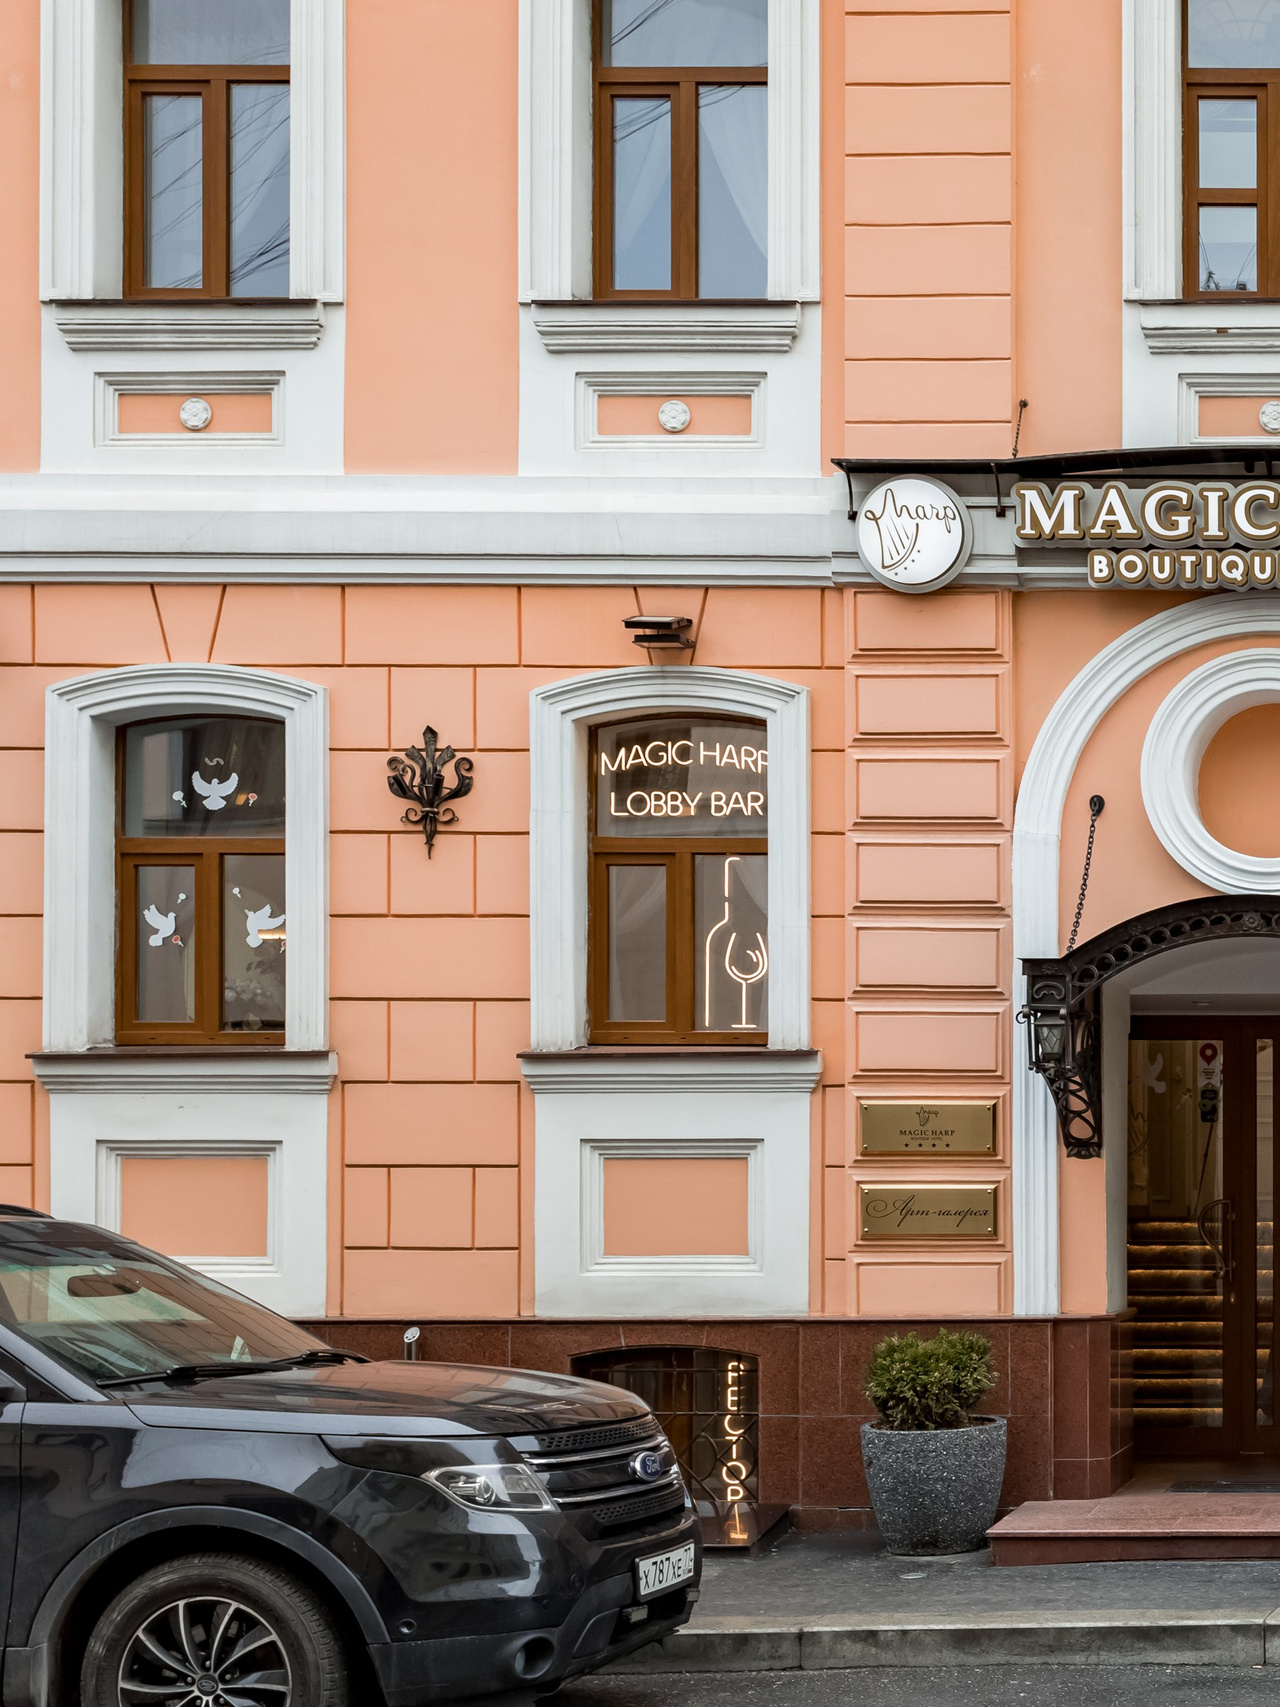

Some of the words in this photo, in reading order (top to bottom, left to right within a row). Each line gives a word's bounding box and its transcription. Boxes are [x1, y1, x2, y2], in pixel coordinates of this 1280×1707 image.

[1018, 487, 1279, 537] MAGIC
[601, 740, 694, 776] MAGIC
[610, 791, 703, 817] LOBBY
[710, 791, 764, 817] BAR
[866, 1194, 990, 1227] Арт-галерея
